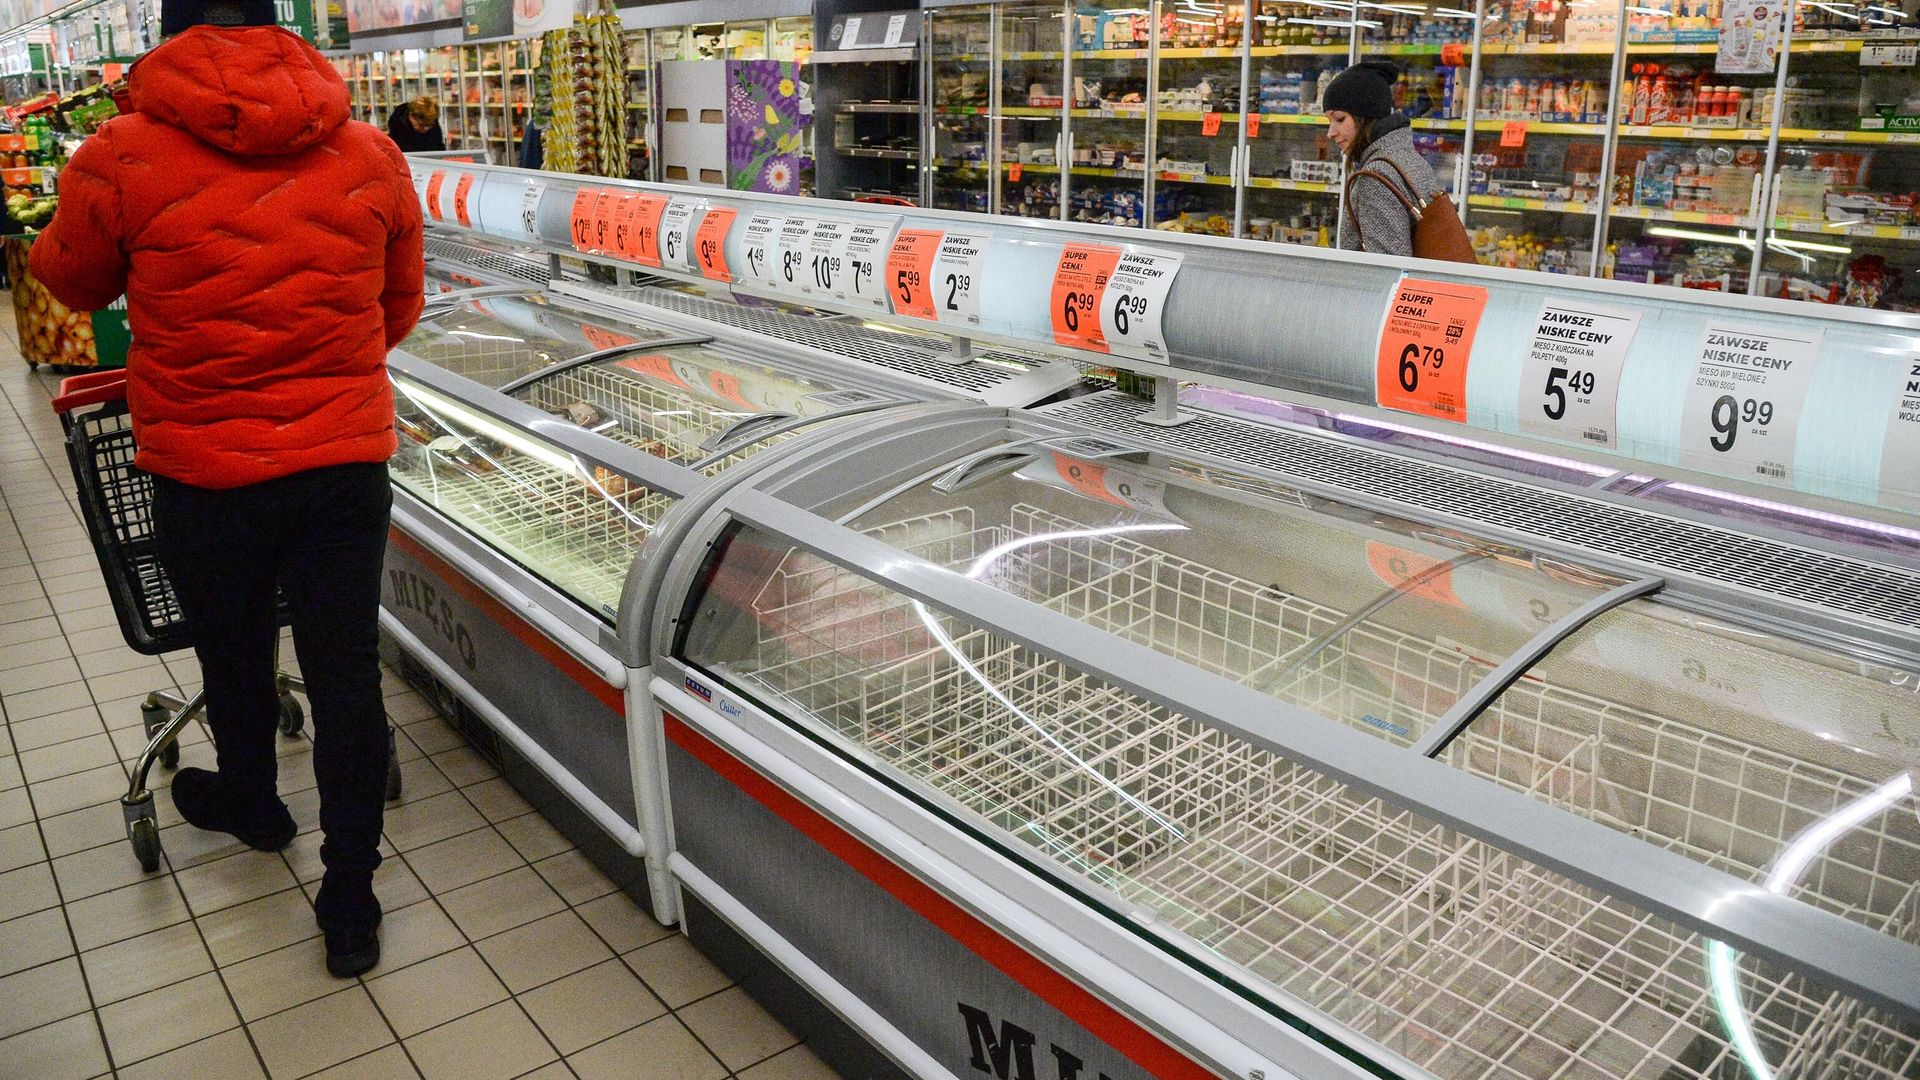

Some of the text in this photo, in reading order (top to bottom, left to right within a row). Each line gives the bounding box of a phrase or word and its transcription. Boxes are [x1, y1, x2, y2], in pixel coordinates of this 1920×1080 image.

[785, 219, 805, 227] ZAWSZE
[813, 231, 842, 240] NISKIE CENY
[853, 227, 875, 235] ZAWSZE
[849, 235, 880, 245] NISKIE CENY
[945, 236, 971, 246] ZAWSZE
[942, 245, 979, 256] NISKIE CENY
[1064, 251, 1088, 261] SUPER
[1122, 253, 1155, 266] ZAWSZE
[1061, 261, 1083, 270] CENA!
[1118, 263, 1164, 278] NISKIE CENY
[1400, 292, 1434, 306] SUPER
[1395, 305, 1427, 318] CENA!
[1542, 312, 1594, 327] ZAWSZE
[1537, 325, 1613, 344] NISKIE CENY
[1707, 334, 1768, 351] ZAWSZE
[1530, 350, 1555, 361] PULPETY
[1556, 344, 1584, 356] KURCZAKA
[1585, 349, 1594, 357] NA
[1702, 348, 1792, 371] NISKIE CENY
[1720, 370, 1731, 378] WP
[1696, 377, 1719, 388] SZYNKI
[720, 699, 742, 718] Chiller
